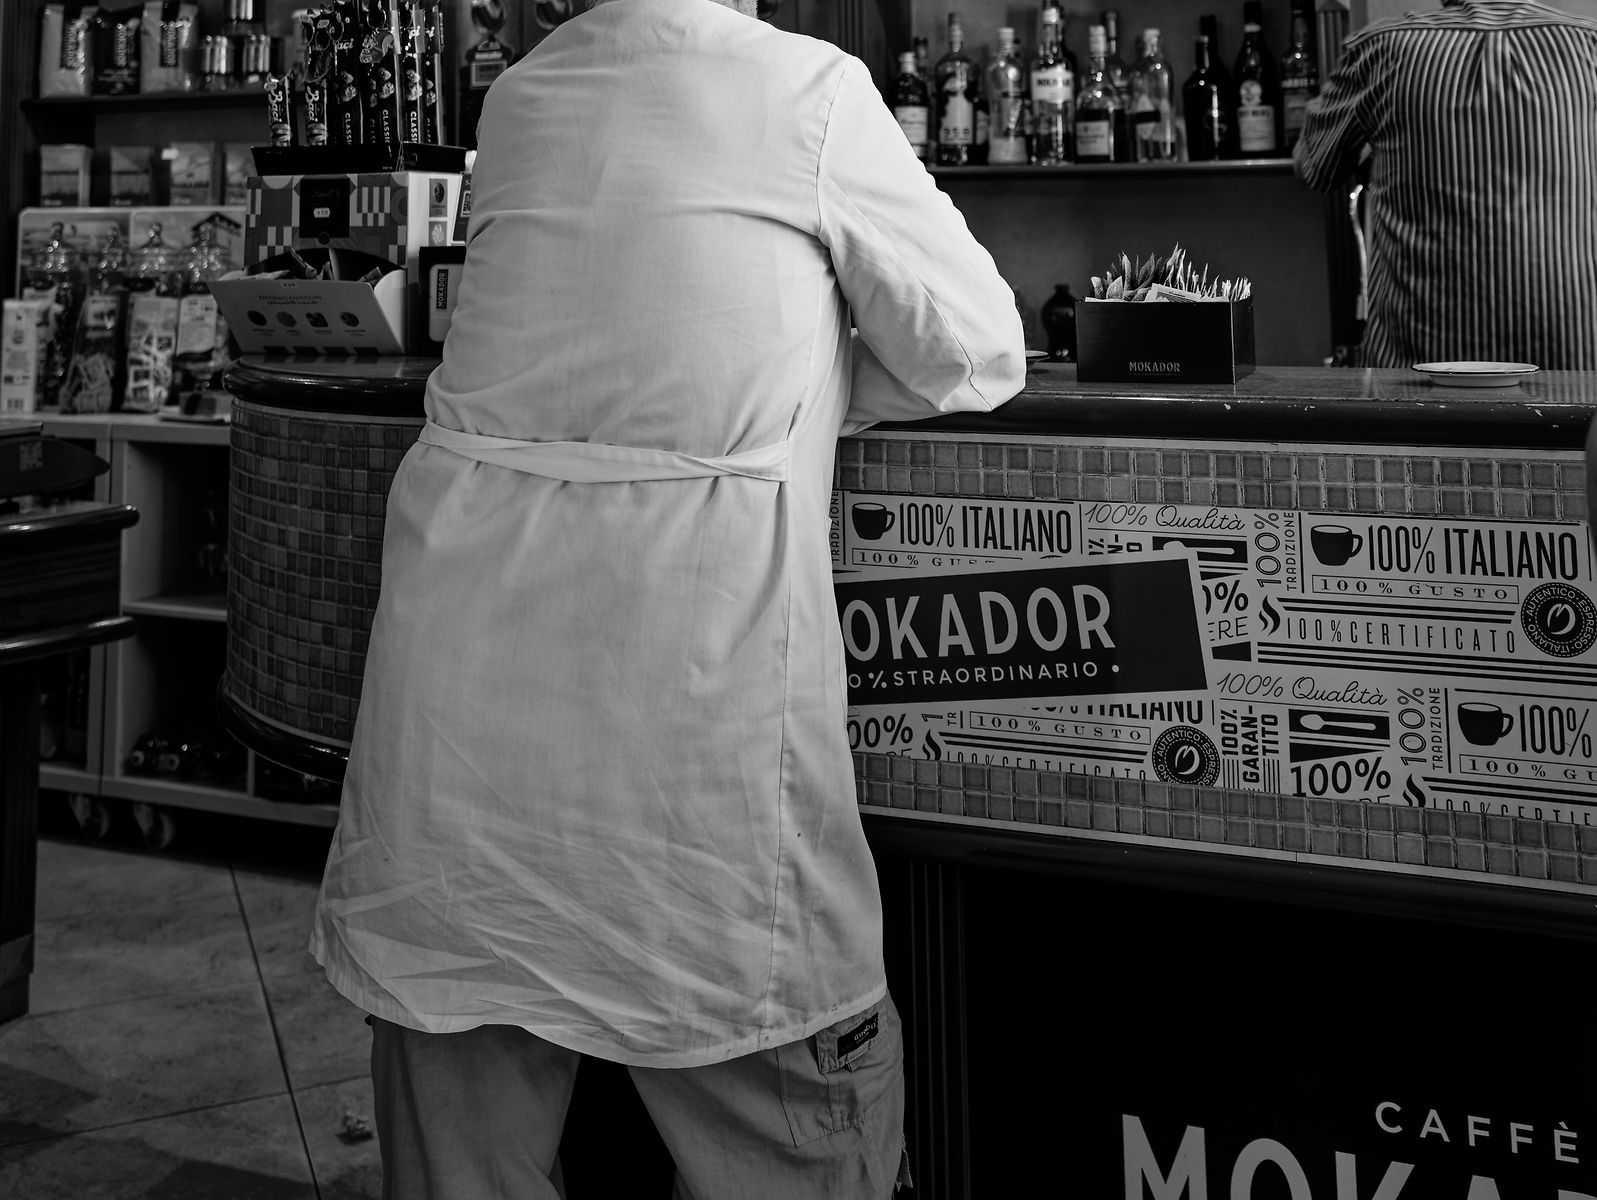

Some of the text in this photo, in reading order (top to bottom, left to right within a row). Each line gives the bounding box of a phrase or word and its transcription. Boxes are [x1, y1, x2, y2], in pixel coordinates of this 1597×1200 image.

[267, 89, 283, 122] Baci
[305, 86, 319, 122] Baci
[437, 271, 447, 308] MOKADOR
[1128, 361, 1181, 373] MOKADOR
[900, 502, 954, 548] 100%
[962, 505, 1073, 554] ITALIANO
[1084, 503, 1246, 532] 100% Qualità
[1253, 511, 1282, 588] 100%
[1283, 511, 1297, 592] TRADIZIONE
[1368, 524, 1579, 581] 100% ITALIANO
[1408, 584, 1508, 600] GUSTO
[1525, 587, 1576, 617] AUTENTICO
[842, 584, 1116, 662] OKADOR
[1527, 623, 1570, 654] ITALIANO
[1574, 599, 1595, 649] ESPRESSO
[1216, 672, 1388, 706] 100% Qualità
[847, 713, 913, 750] 00%
[1054, 723, 1142, 741] GUSTO
[1159, 729, 1201, 757] AUTENTICO
[1220, 709, 1239, 756] 100%
[1240, 705, 1260, 783] GARAN-
[1260, 714, 1279, 756] TITO
[1397, 687, 1427, 766] 100%
[1429, 687, 1444, 770] TRADIZIONE
[1519, 704, 1592, 758] 100%
[1290, 756, 1391, 797] 100%
[1375, 1101, 1580, 1164] CAFFÈ
